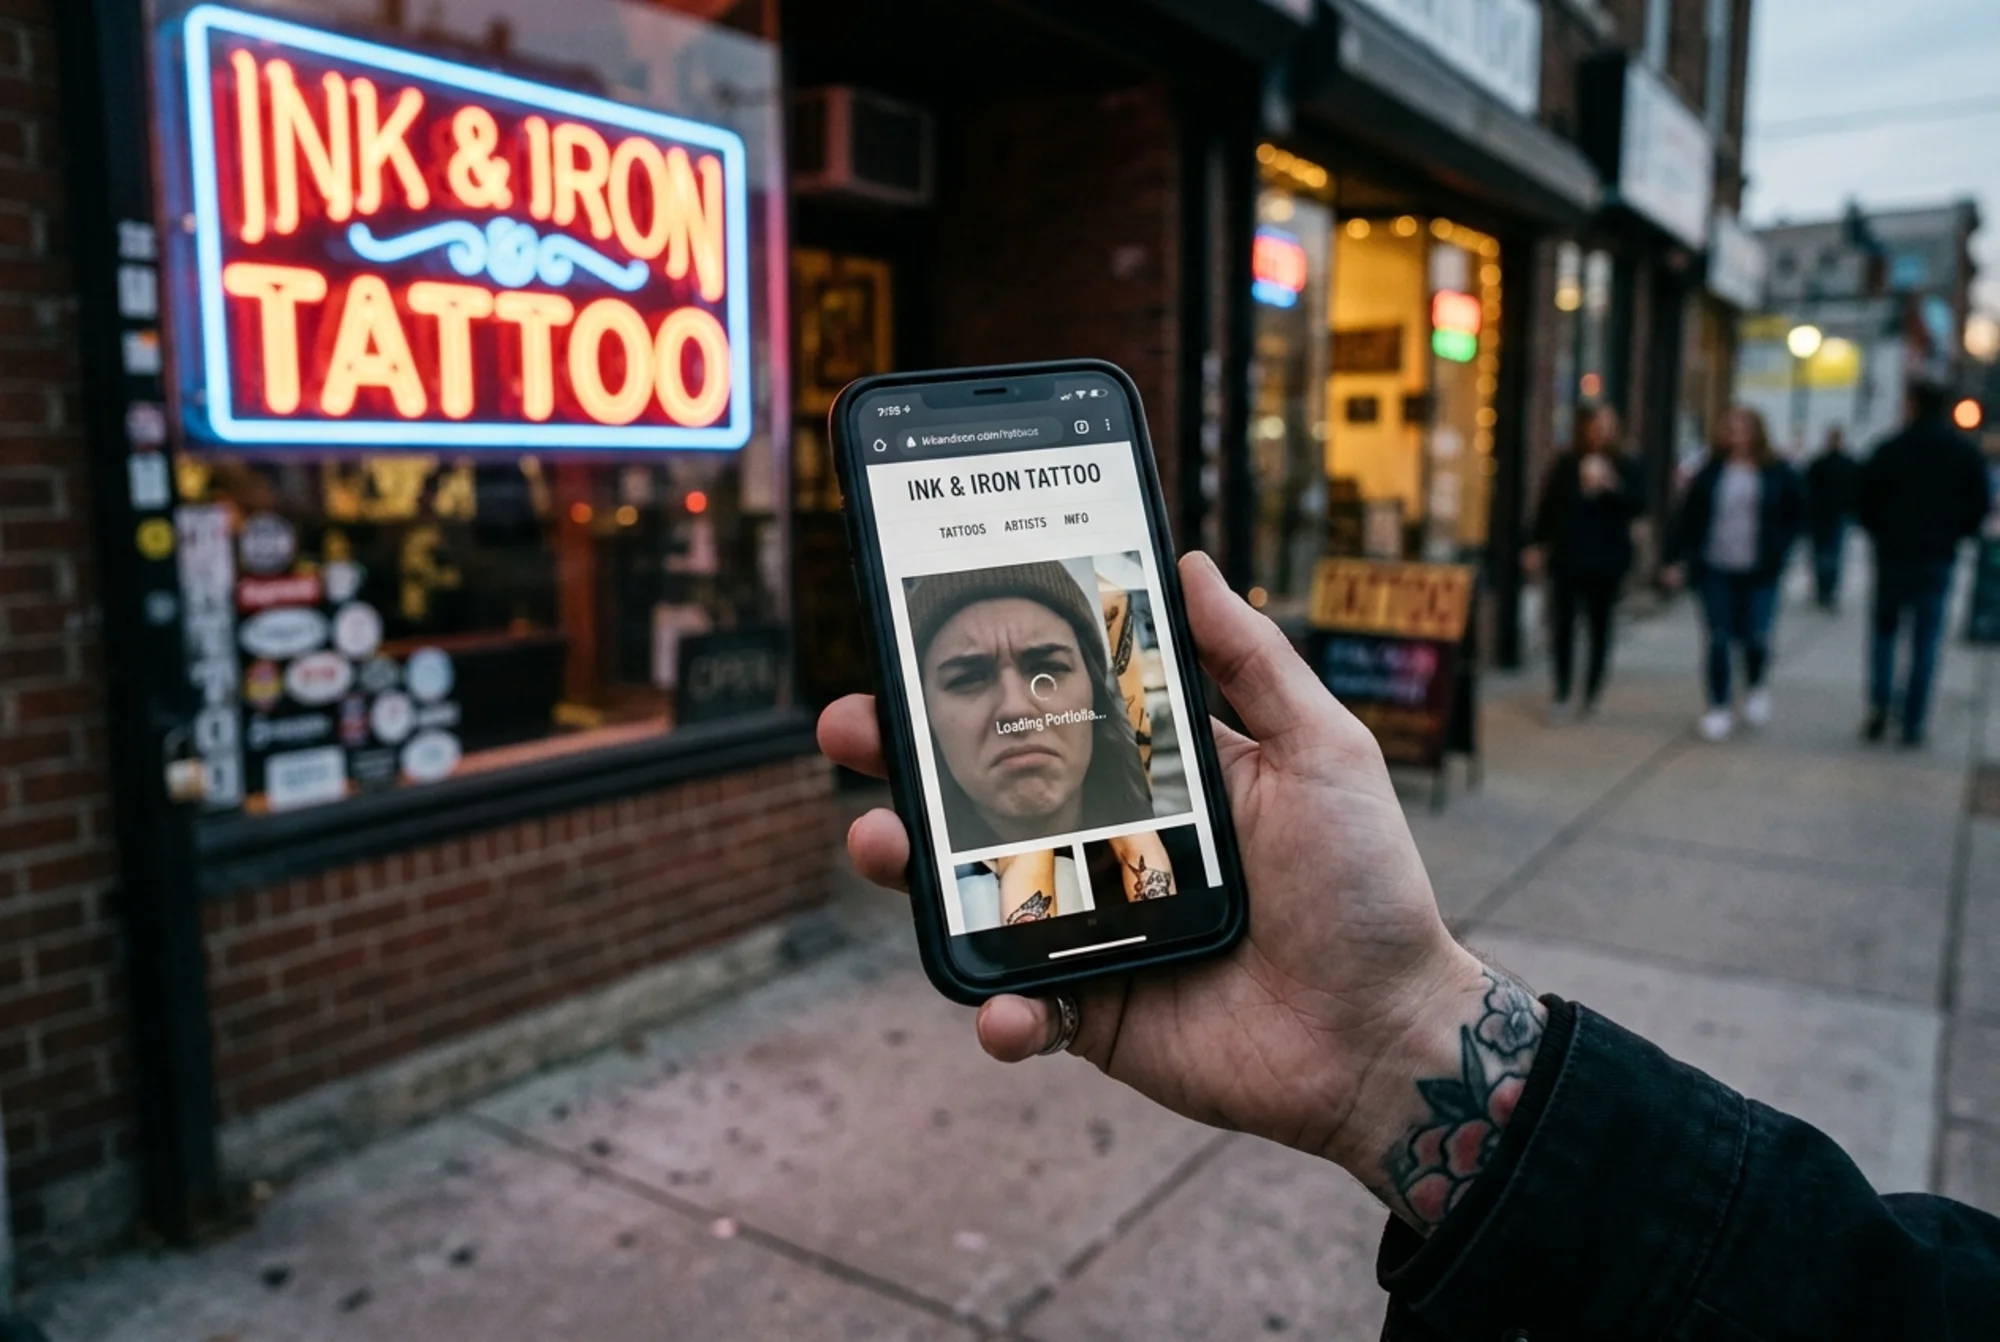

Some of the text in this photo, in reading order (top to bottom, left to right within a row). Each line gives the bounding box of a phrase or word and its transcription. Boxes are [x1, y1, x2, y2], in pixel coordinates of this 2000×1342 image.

[230, 48, 724, 303] INK & IRON
[222, 262, 731, 428] TATTOO
[908, 462, 1101, 501] INK & IRON TATTOO
[939, 523, 987, 539] TATTOOS
[996, 717, 1044, 735] Loading
